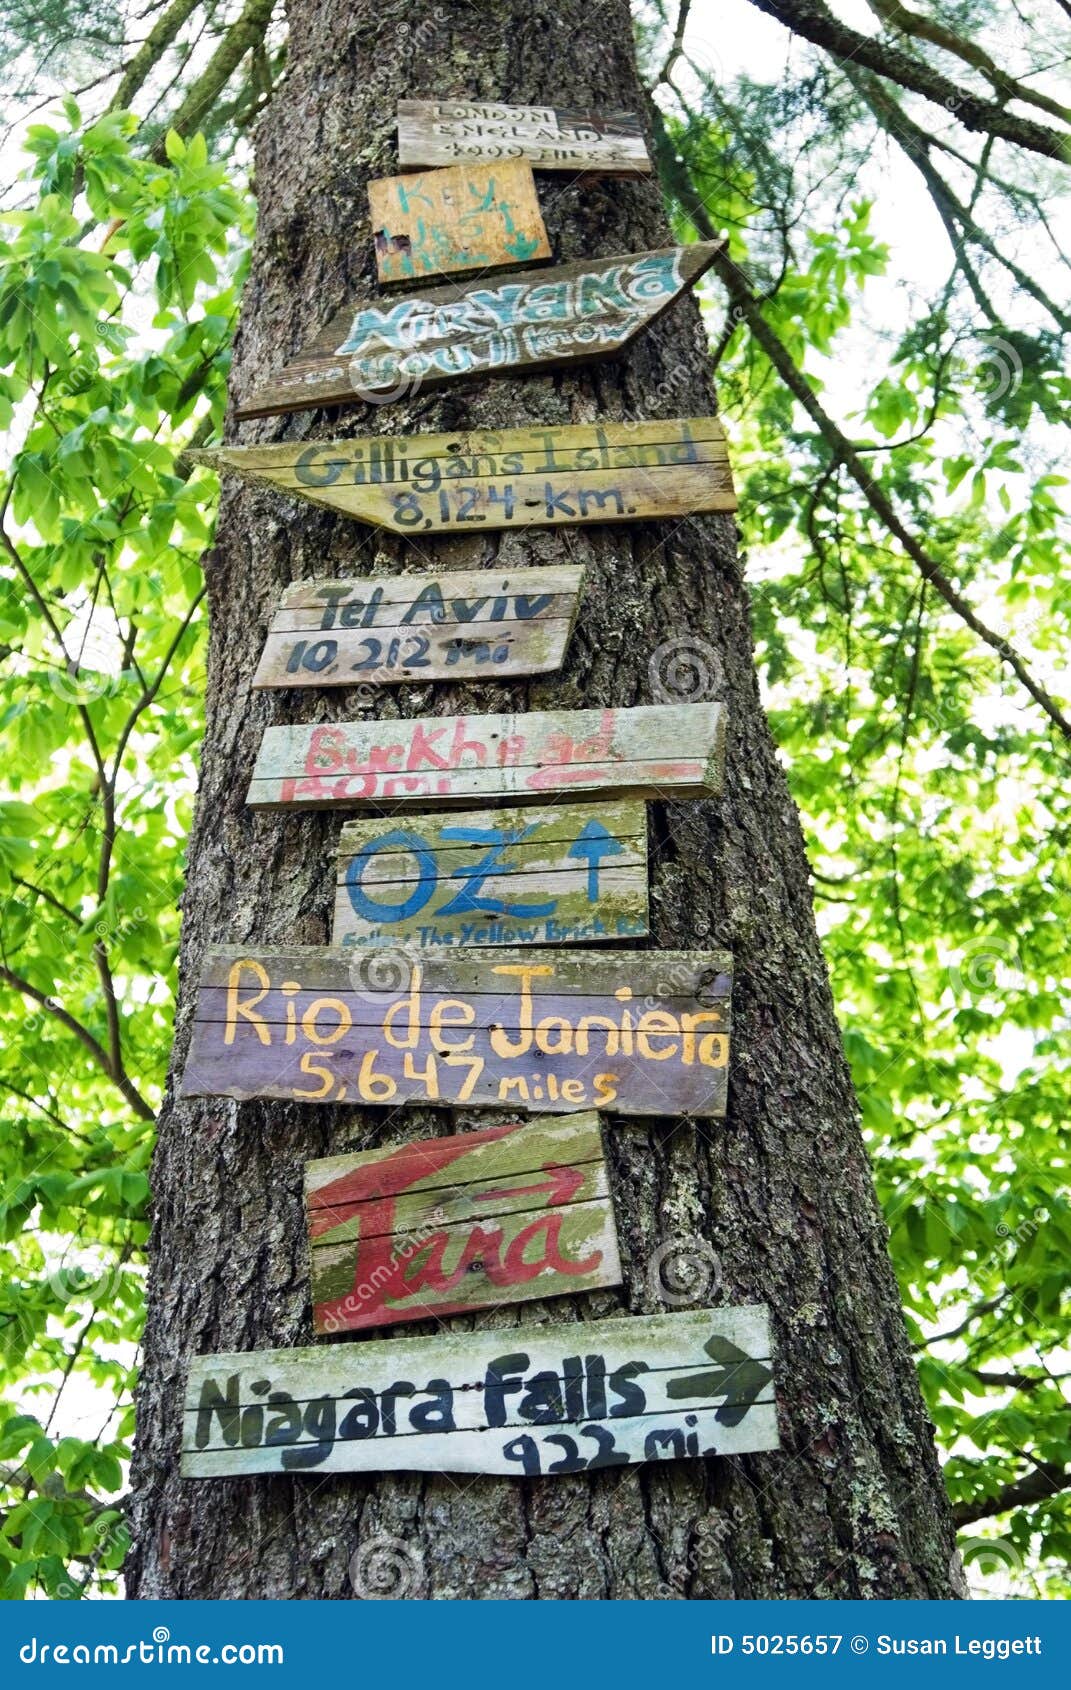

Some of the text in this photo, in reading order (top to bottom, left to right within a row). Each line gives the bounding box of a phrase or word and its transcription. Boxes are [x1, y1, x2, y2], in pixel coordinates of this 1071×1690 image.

[434, 106, 551, 122] LONDON
[438, 124, 604, 143] ENGLAND
[294, 422, 698, 493] Gilligan's Island
[393, 484, 515, 530] 8,124
[316, 580, 555, 630] Tel Aviv
[418, 925, 453, 948] The
[457, 922, 538, 946] Yellow
[545, 918, 606, 941] Brick
[224, 960, 729, 1068] Rio de Janiero
[293, 1049, 485, 1102] 5,647
[308, 1124, 602, 1318] Tara
[197, 1352, 650, 1470] Niagara Falls
[503, 1414, 717, 1478] 922 mi.
